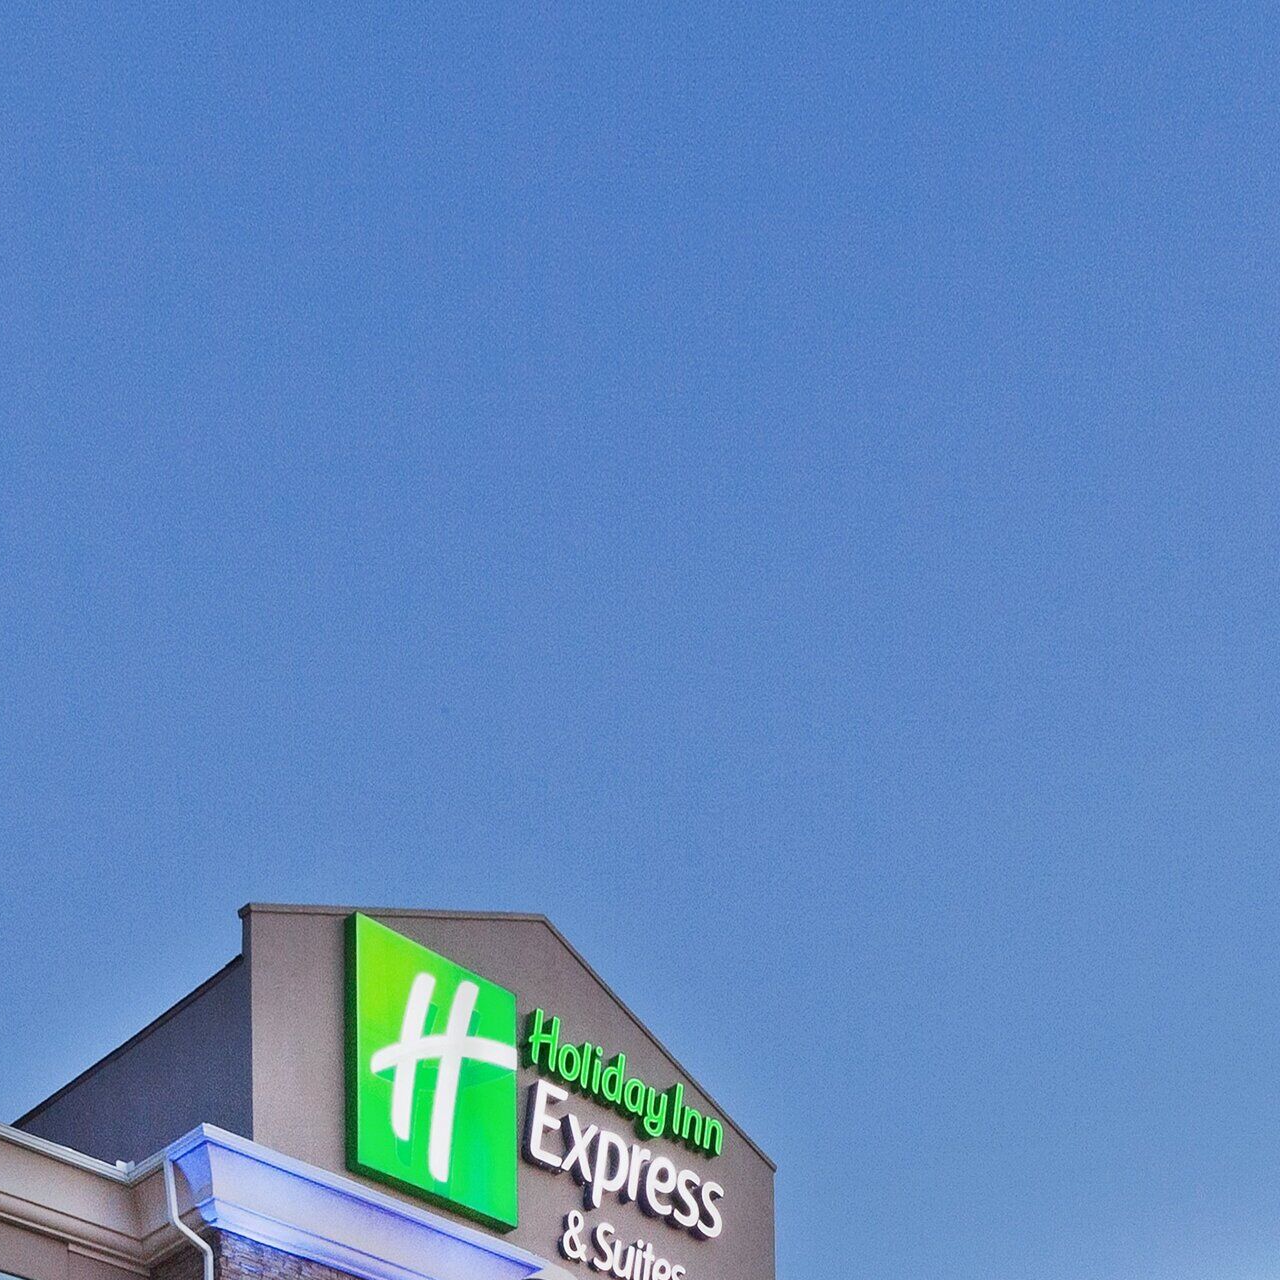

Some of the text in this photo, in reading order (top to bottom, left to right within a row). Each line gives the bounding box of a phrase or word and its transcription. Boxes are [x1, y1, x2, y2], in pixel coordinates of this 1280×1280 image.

[527, 1007, 724, 1156] Holiday Inn
[526, 1078, 725, 1239] Express
[561, 1208, 588, 1263] &
